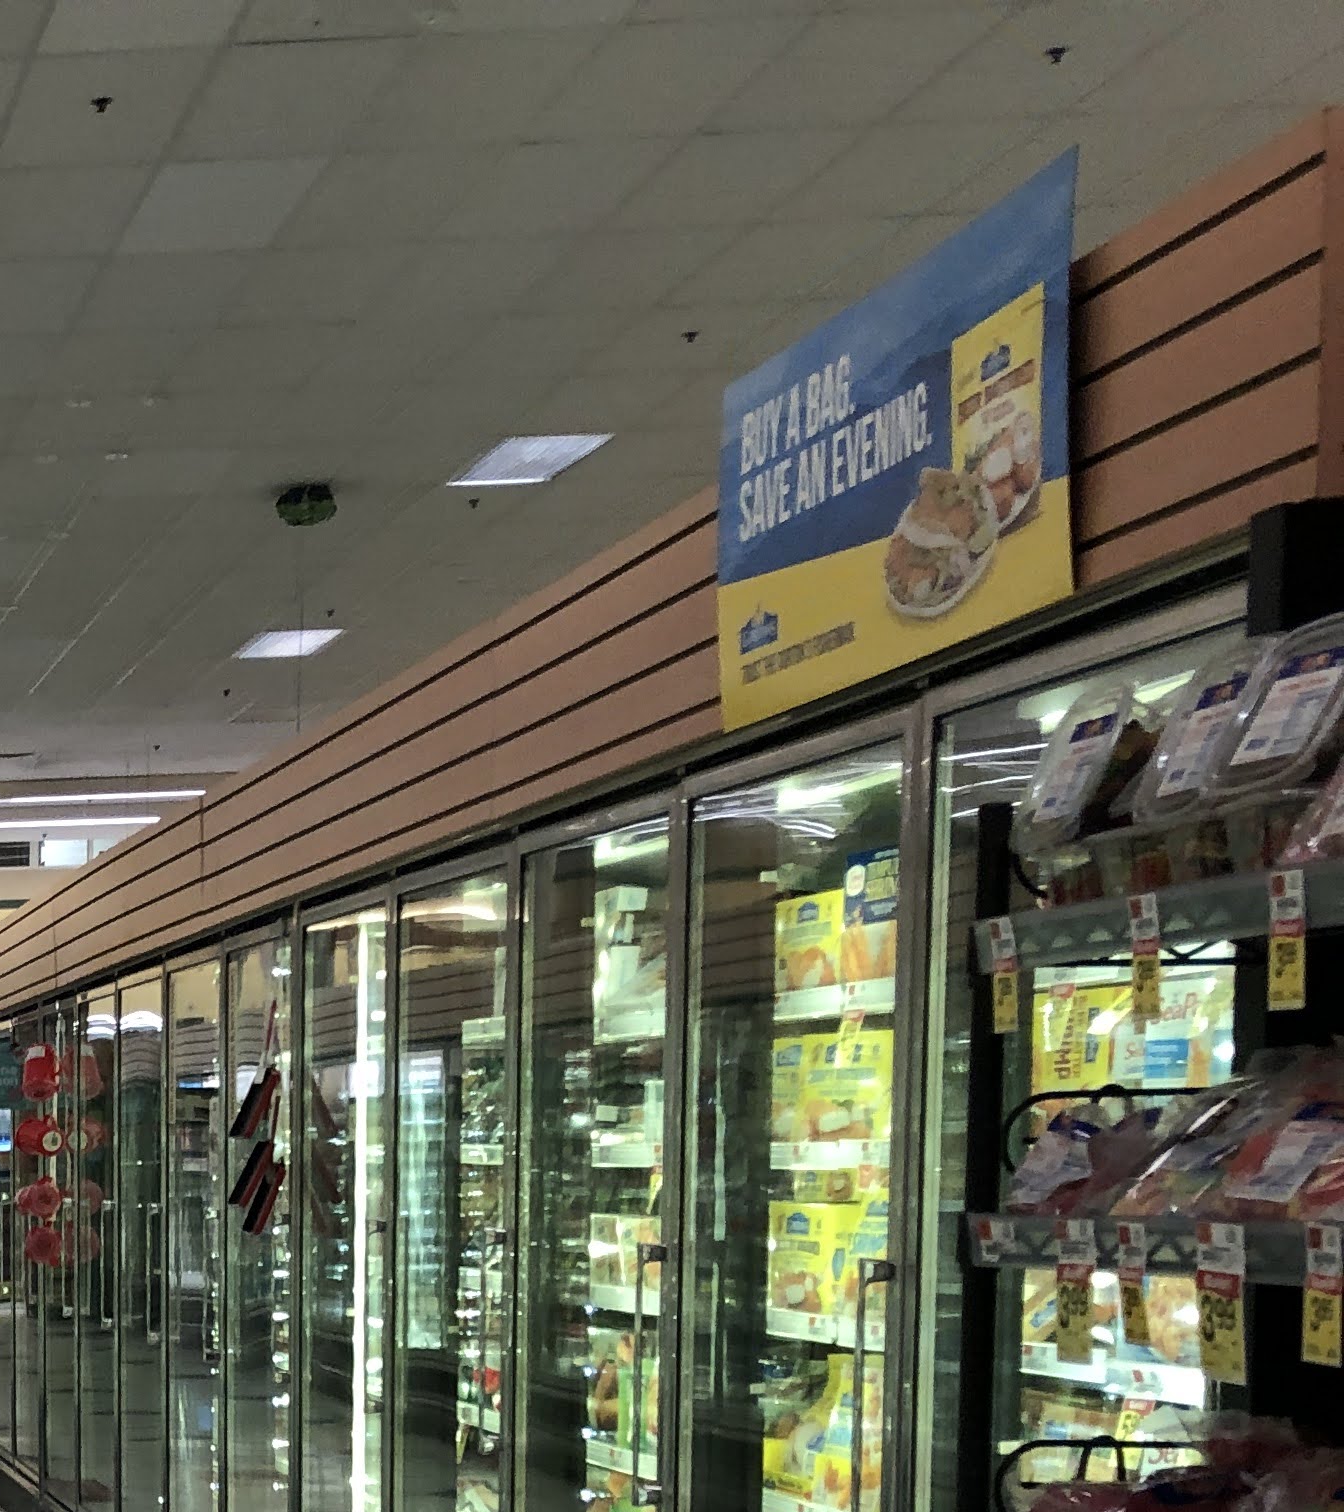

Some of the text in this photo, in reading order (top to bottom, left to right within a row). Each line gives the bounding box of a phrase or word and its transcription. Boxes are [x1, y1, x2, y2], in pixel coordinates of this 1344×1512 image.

[739, 458, 793, 542] SAVE
[796, 438, 827, 515] AN
[830, 381, 932, 497] EVENING.
[740, 353, 855, 476] BUY A BAG.
